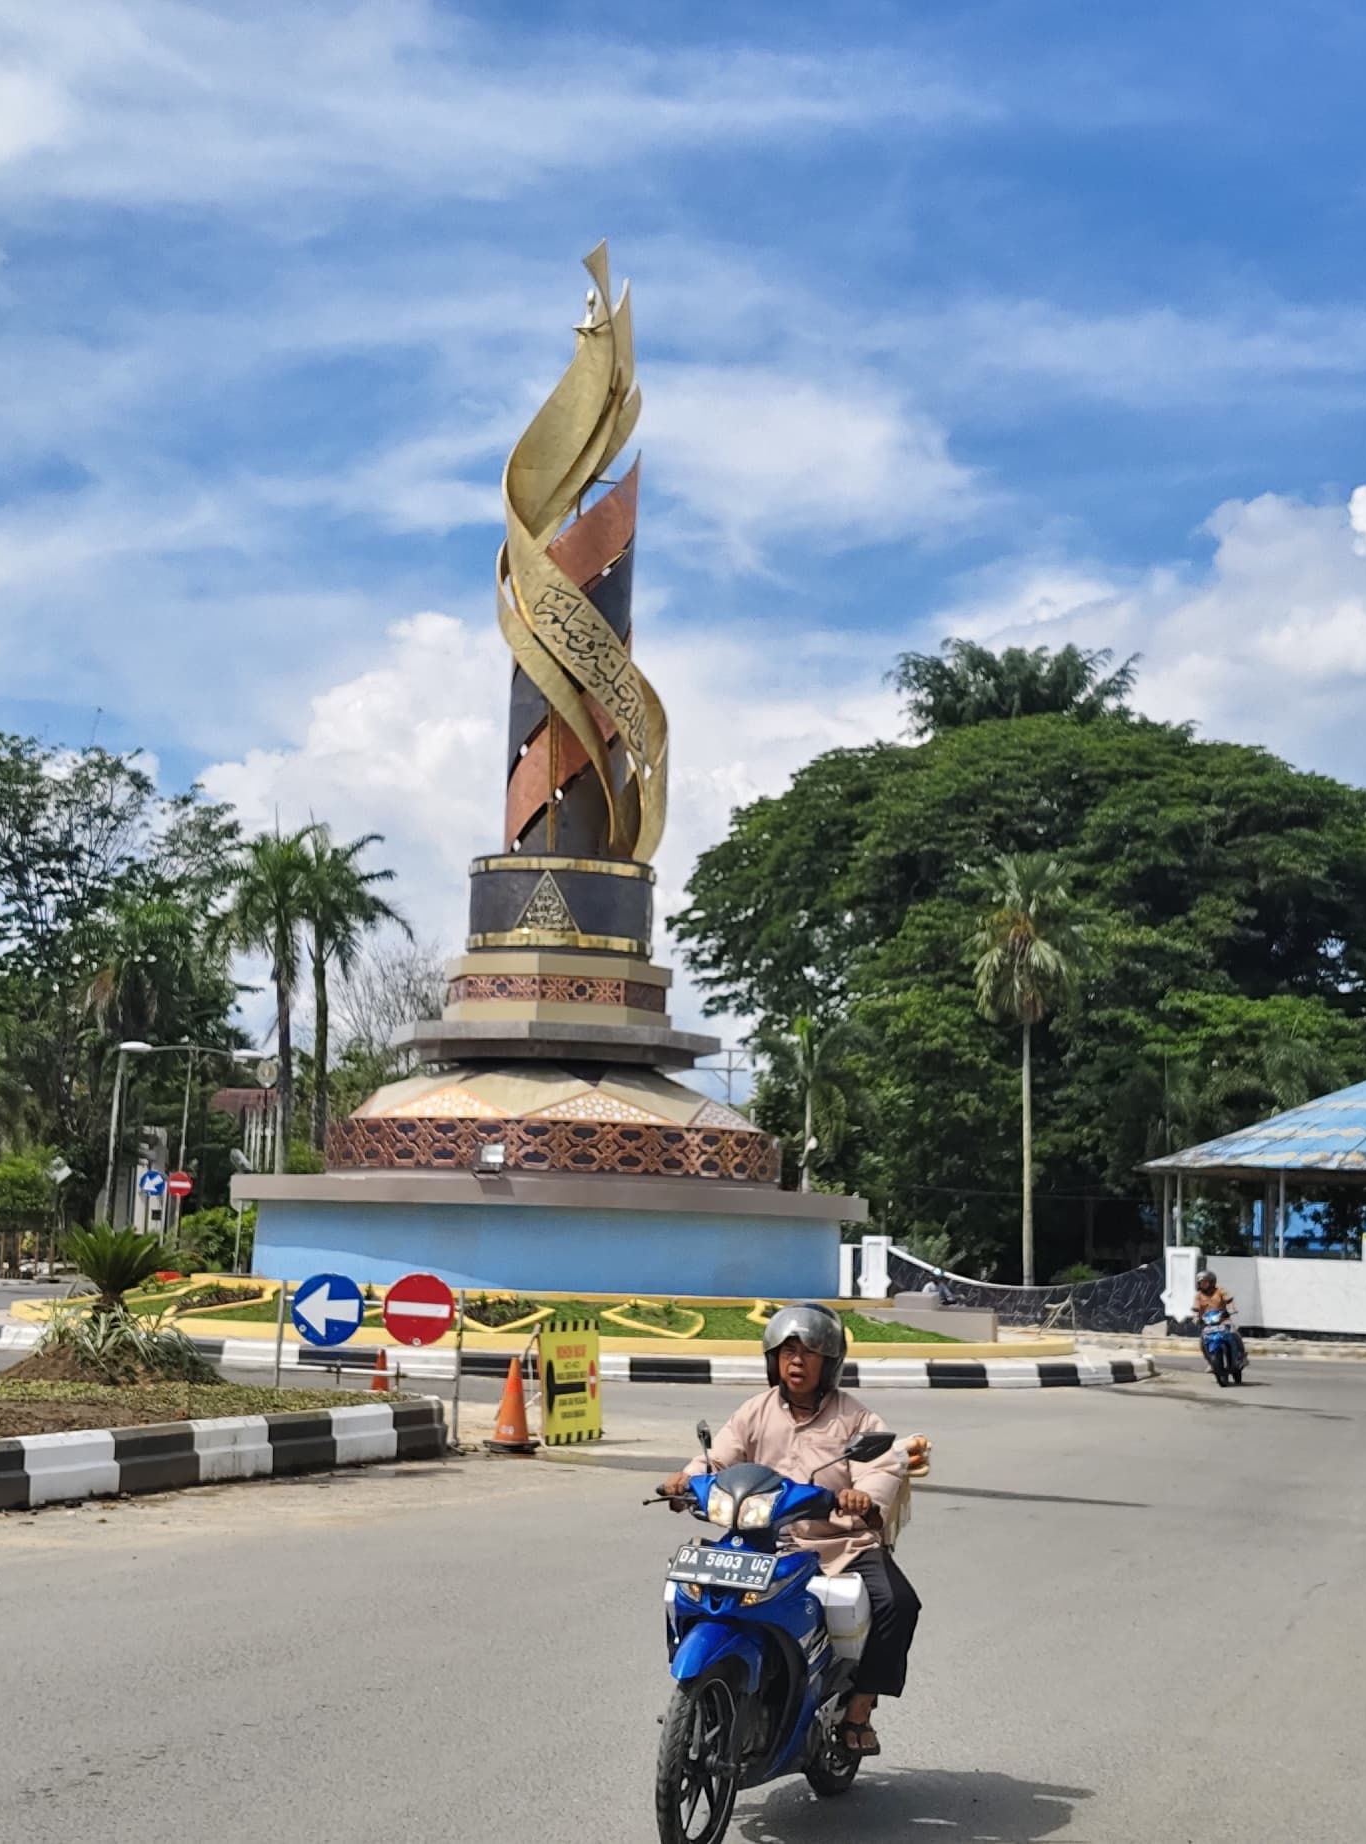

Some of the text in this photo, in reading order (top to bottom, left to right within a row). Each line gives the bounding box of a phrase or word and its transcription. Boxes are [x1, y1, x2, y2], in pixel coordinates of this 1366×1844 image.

[679, 1549, 771, 1572] DA 5803 UC
